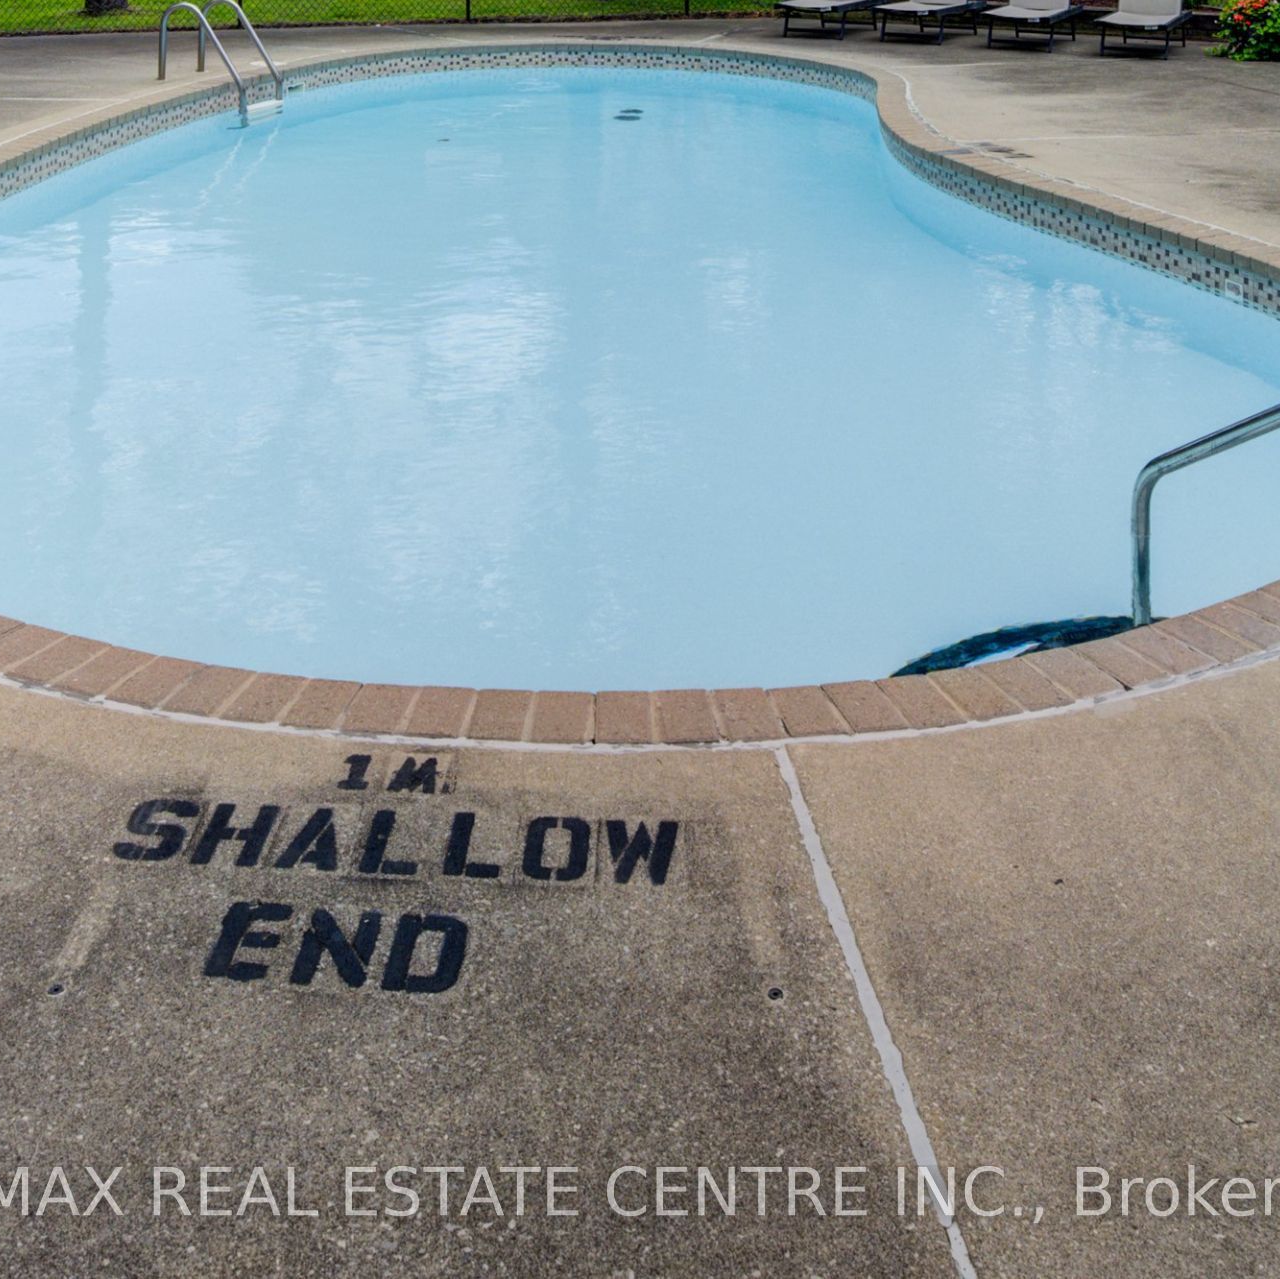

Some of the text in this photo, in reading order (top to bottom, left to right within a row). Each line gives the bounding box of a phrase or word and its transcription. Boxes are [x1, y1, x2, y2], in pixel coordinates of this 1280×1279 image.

[336, 753, 373, 791] 1
[112, 798, 679, 887] SHALLOW
[202, 900, 470, 994] END
